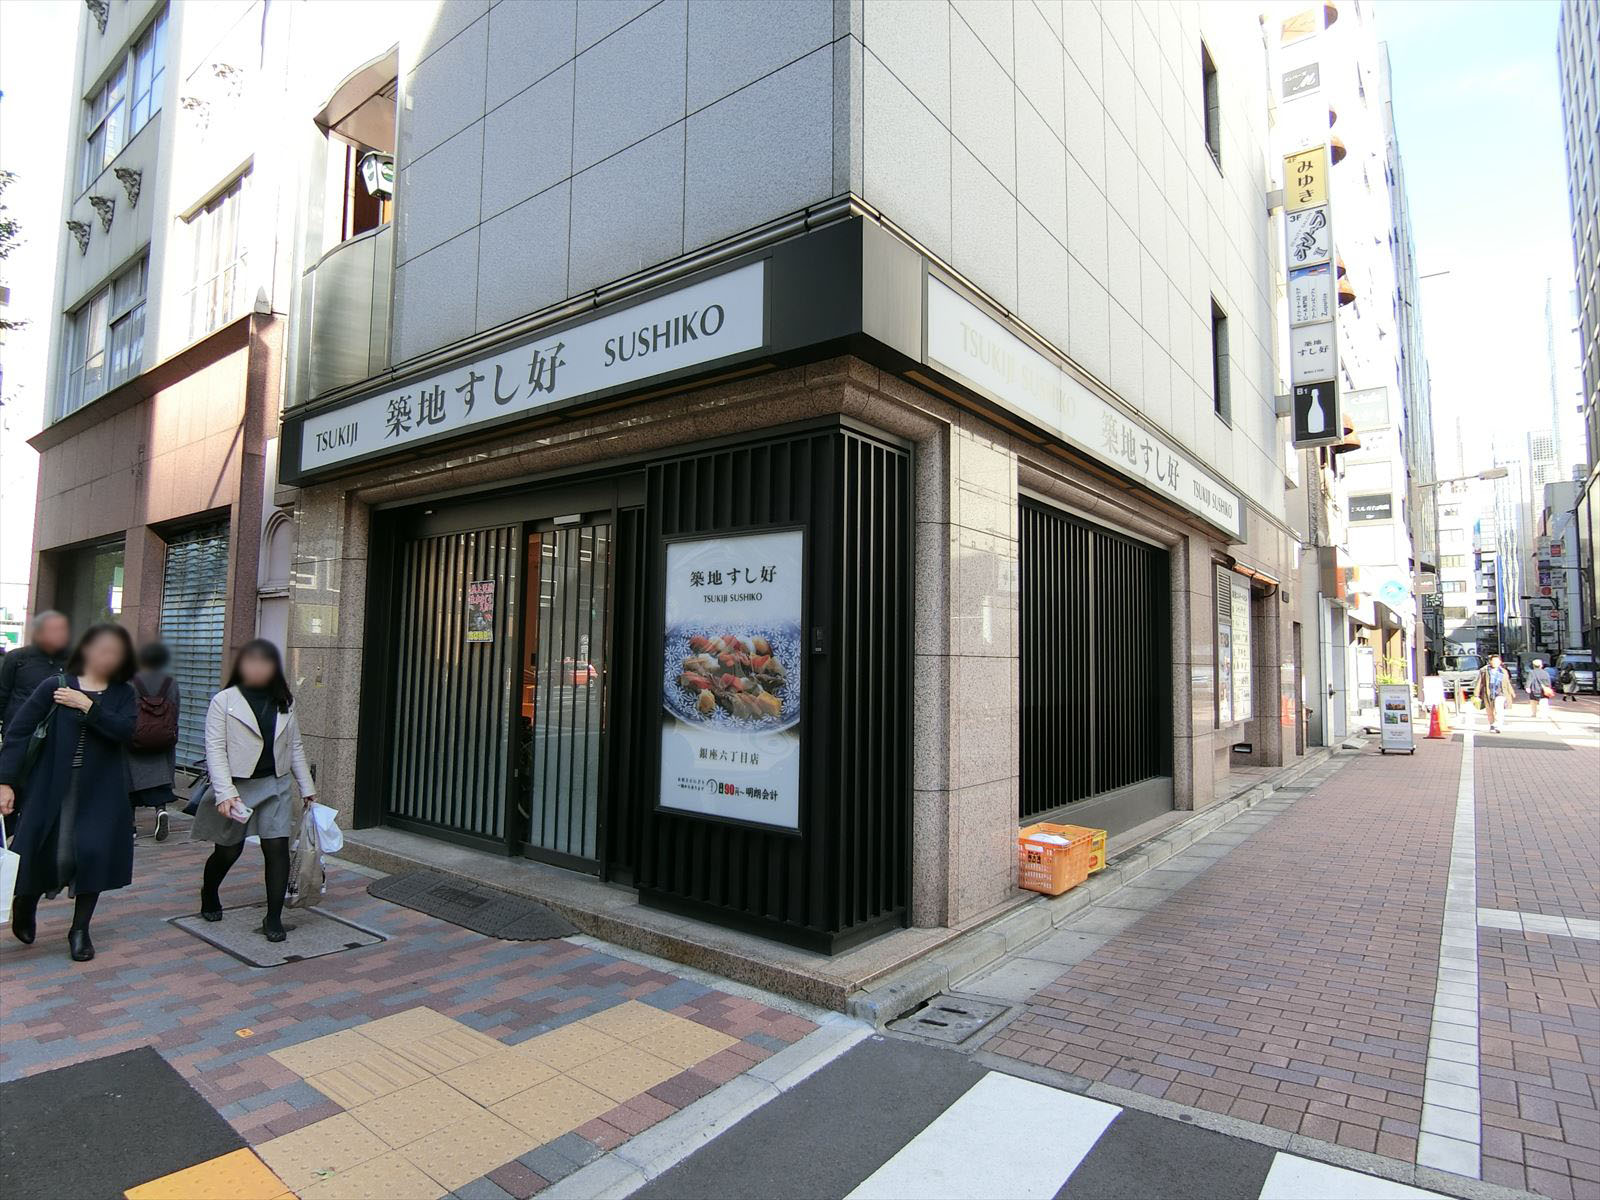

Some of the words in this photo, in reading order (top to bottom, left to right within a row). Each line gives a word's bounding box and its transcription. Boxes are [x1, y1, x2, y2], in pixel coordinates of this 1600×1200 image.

[1297, 160, 1313, 203] みゆき
[1290, 214, 1302, 222] 3F
[604, 304, 725, 367] SUSHIKO
[960, 321, 1014, 384] TSUKIJI
[384, 342, 567, 441] 築地すし好
[1297, 388, 1308, 396] B1
[316, 422, 359, 453] TSUKIJI
[1102, 410, 1180, 491] 築地すし好
[1193, 479, 1211, 508] TSUKIJI
[690, 565, 777, 587] 築地すし好
[704, 594, 728, 604] TSUKIJI
[730, 592, 763, 602] SUSHIKO
[700, 747, 759, 765] 銀座六丁目店
